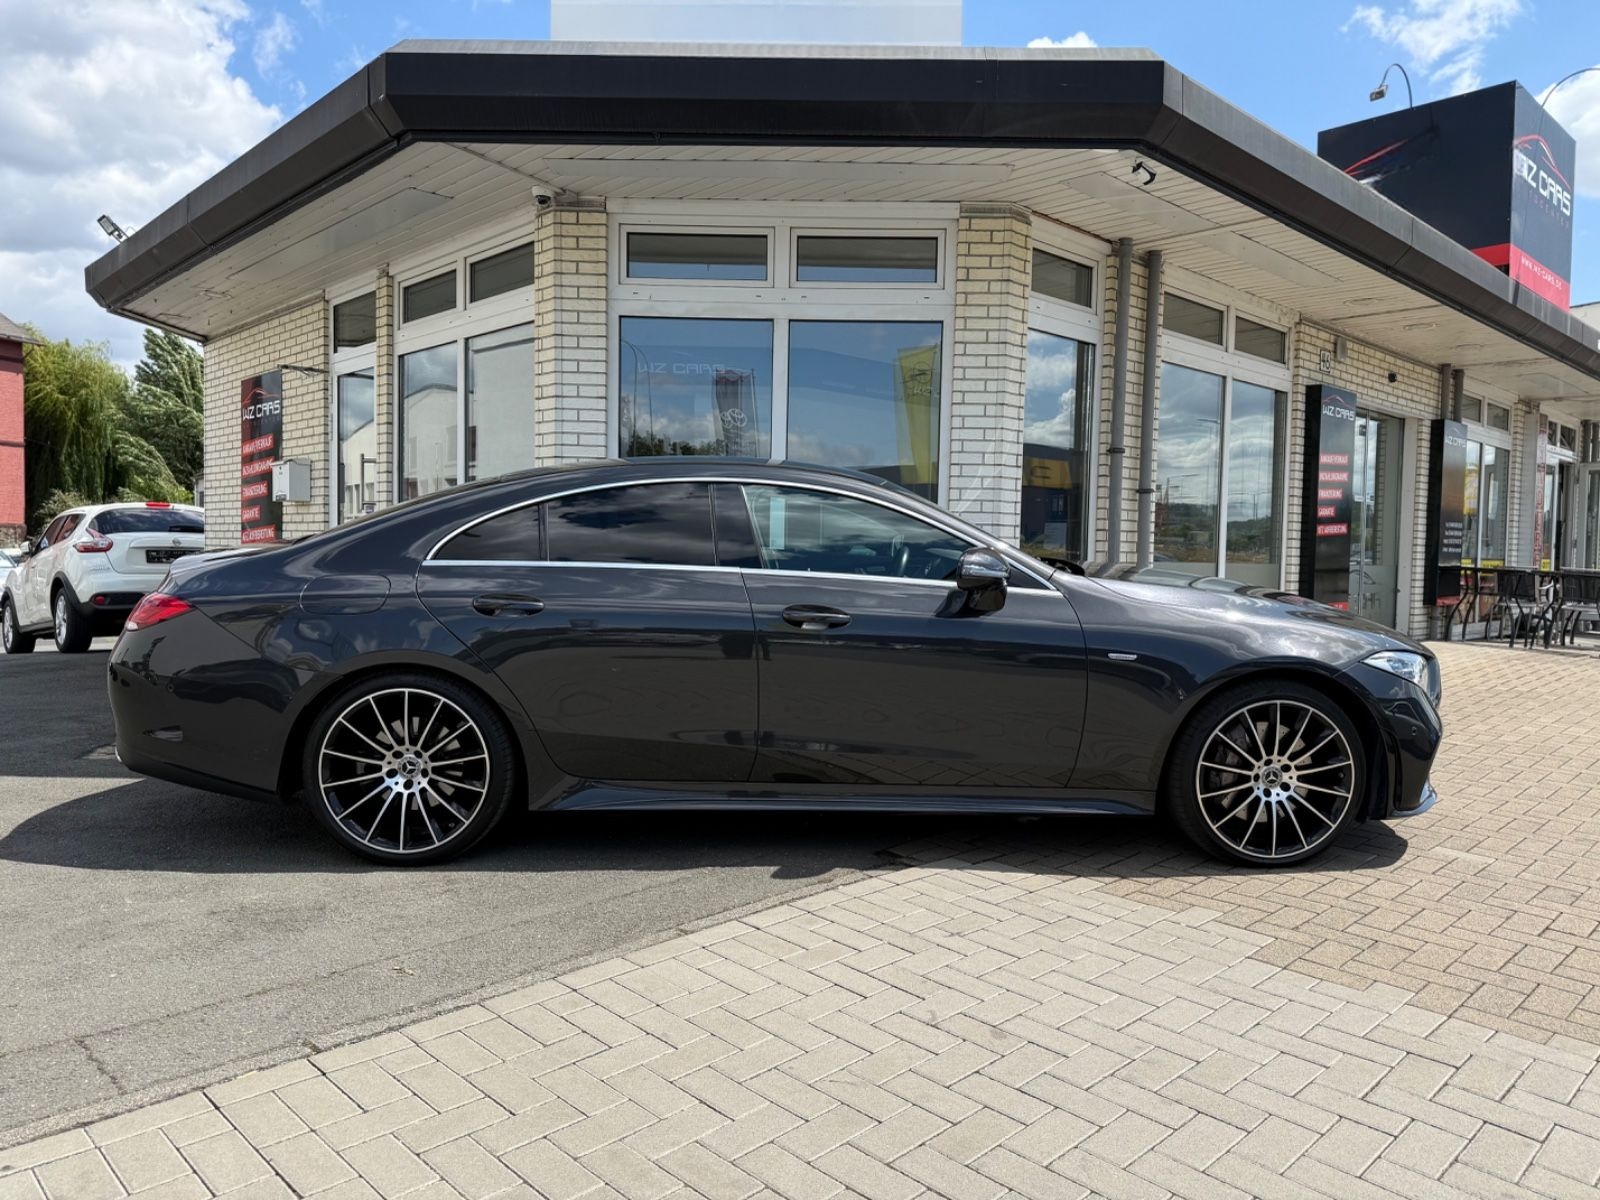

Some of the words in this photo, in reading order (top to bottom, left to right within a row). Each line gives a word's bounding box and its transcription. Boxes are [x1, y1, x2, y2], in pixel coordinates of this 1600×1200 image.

[1539, 170, 1571, 217] CARS
[242, 405, 255, 421] WZ
[256, 400, 280, 418] CARS
[1322, 404, 1334, 417] WZ
